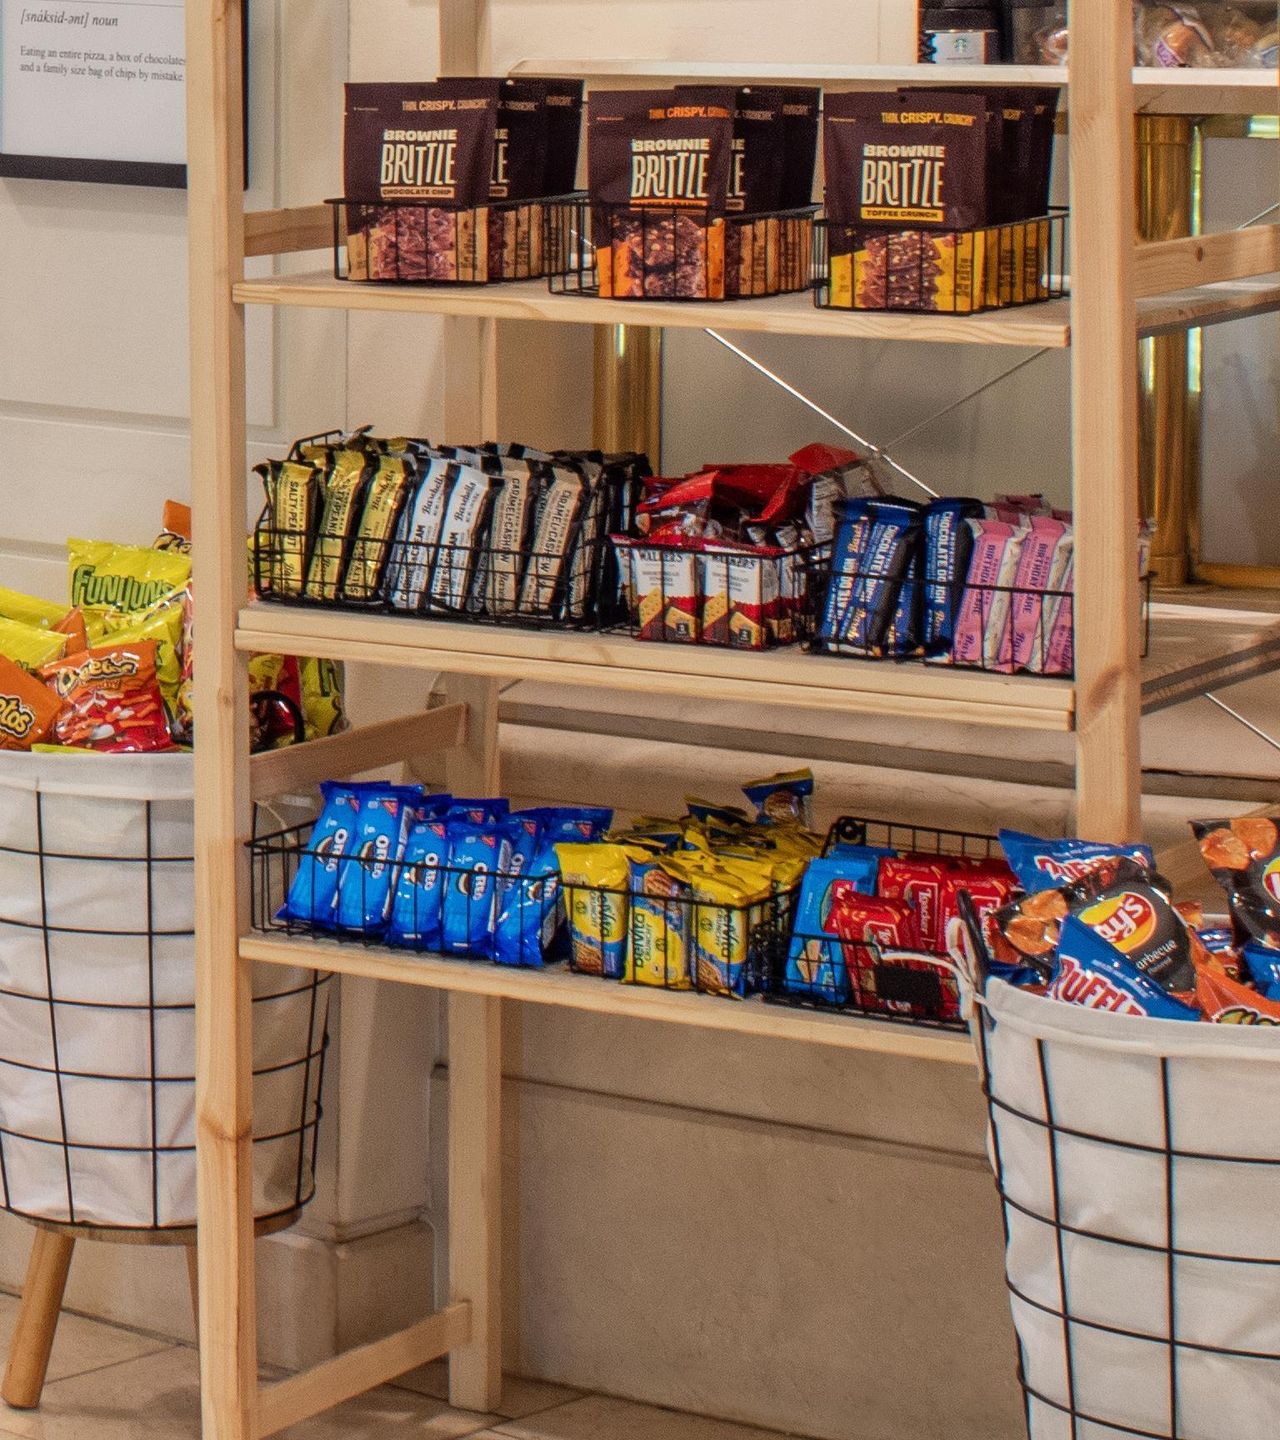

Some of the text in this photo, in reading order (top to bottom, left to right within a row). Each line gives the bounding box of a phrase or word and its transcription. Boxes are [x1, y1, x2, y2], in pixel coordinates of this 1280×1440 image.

[92, 16, 118, 27] noun
[20, 45, 46, 58] Eating
[47, 49, 57, 58] an
[59, 49, 82, 59] entire
[116, 51, 131, 62] box
[133, 52, 143, 62] of
[20, 62, 34, 72] and
[43, 62, 68, 76] family
[71, 66, 86, 75] size
[88, 66, 103, 79] bag
[104, 67, 113, 77] of
[115, 68, 136, 81] chips
[139, 69, 148, 81] by
[383, 128, 458, 142] BROWNIE
[632, 138, 711, 152] BROWNIE
[864, 144, 946, 157] BROWNIE
[381, 142, 458, 186] BRITTLE
[631, 152, 711, 198] BRITTLE
[861, 159, 946, 208] BRITTLE
[382, 188, 430, 196] CHOCOLATE
[901, 211, 938, 219] CRUNCH
[1094, 895, 1144, 943] ay's
